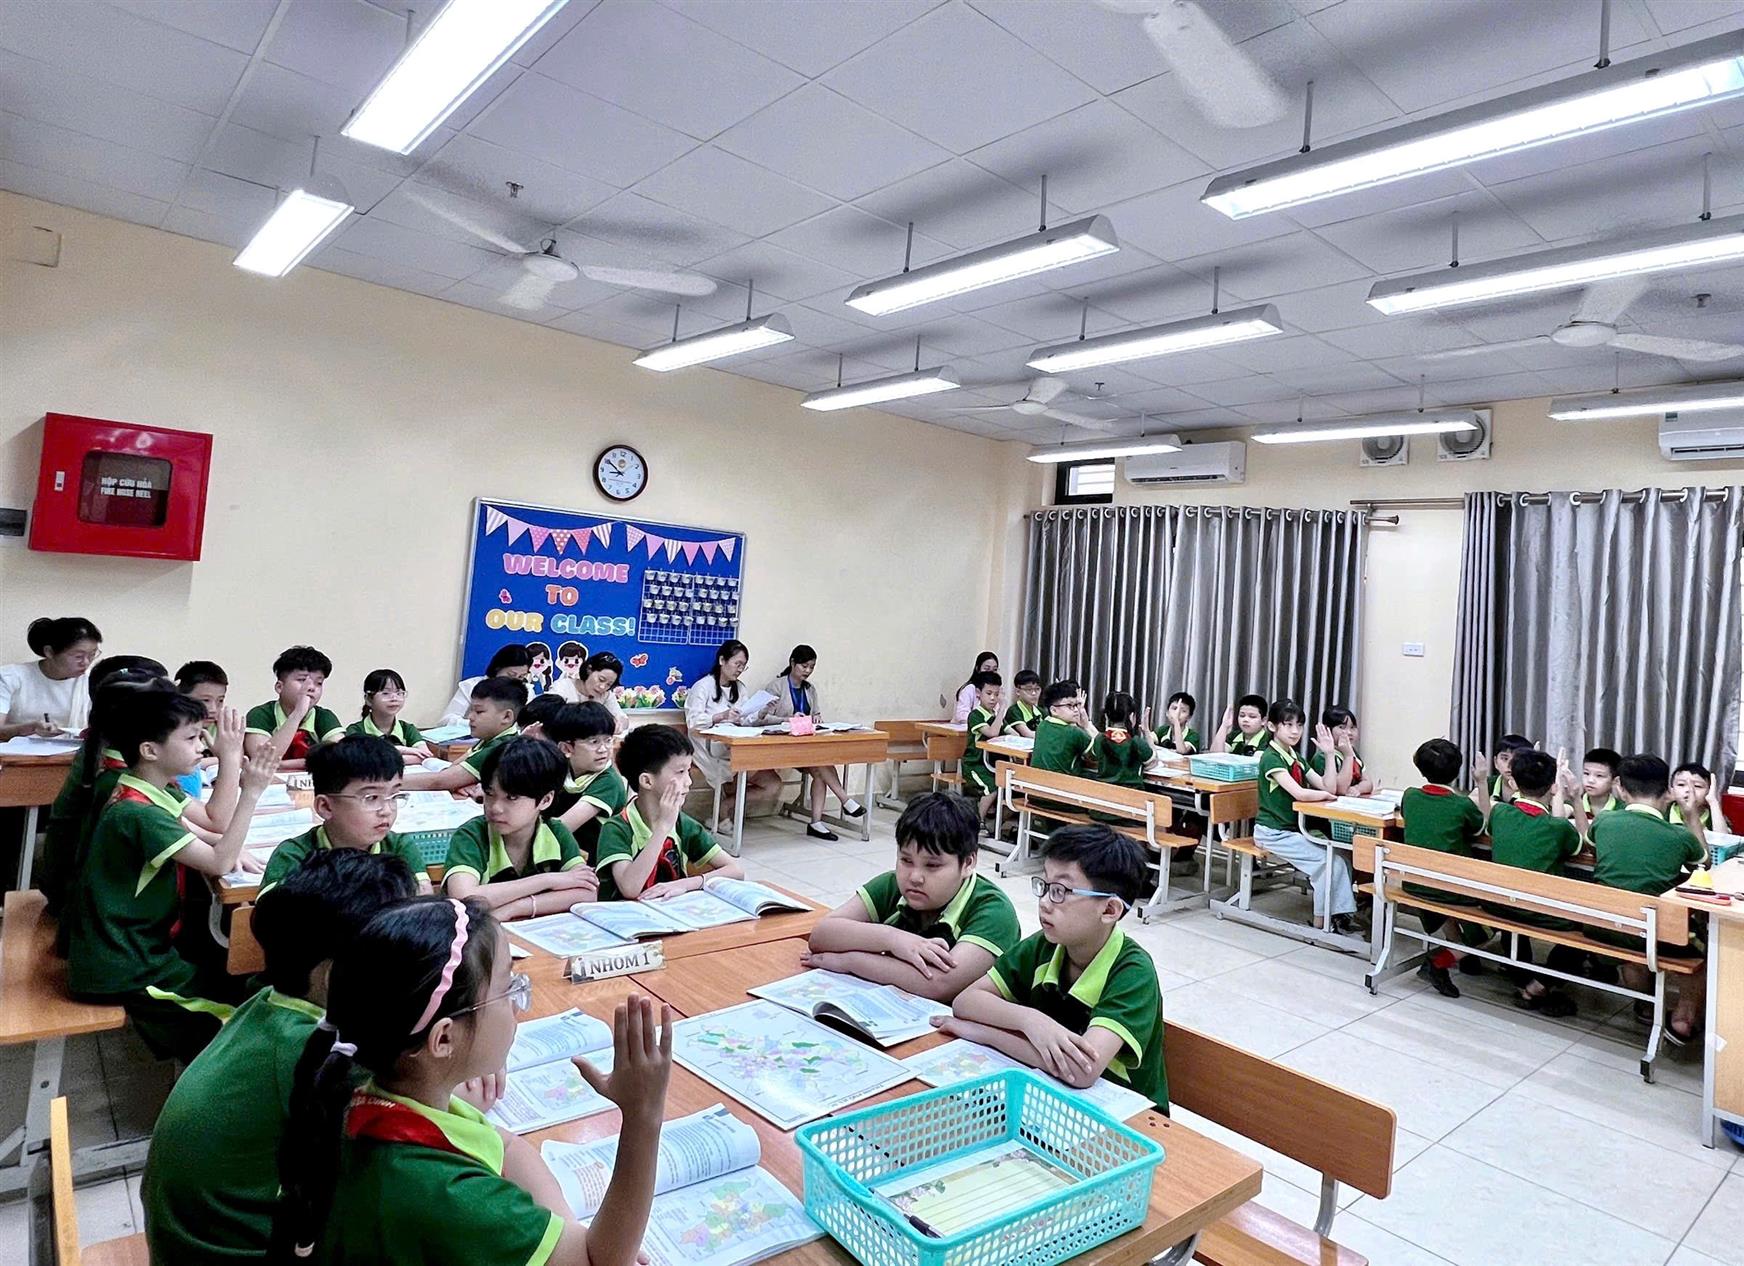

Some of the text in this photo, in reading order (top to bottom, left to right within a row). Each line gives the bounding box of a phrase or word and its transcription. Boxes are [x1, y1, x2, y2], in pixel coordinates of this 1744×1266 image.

[503, 553, 629, 583] WELCOME
[545, 584, 579, 606] TO
[486, 608, 636, 636] OUR CLASS!
[642, 951, 650, 965] 1
